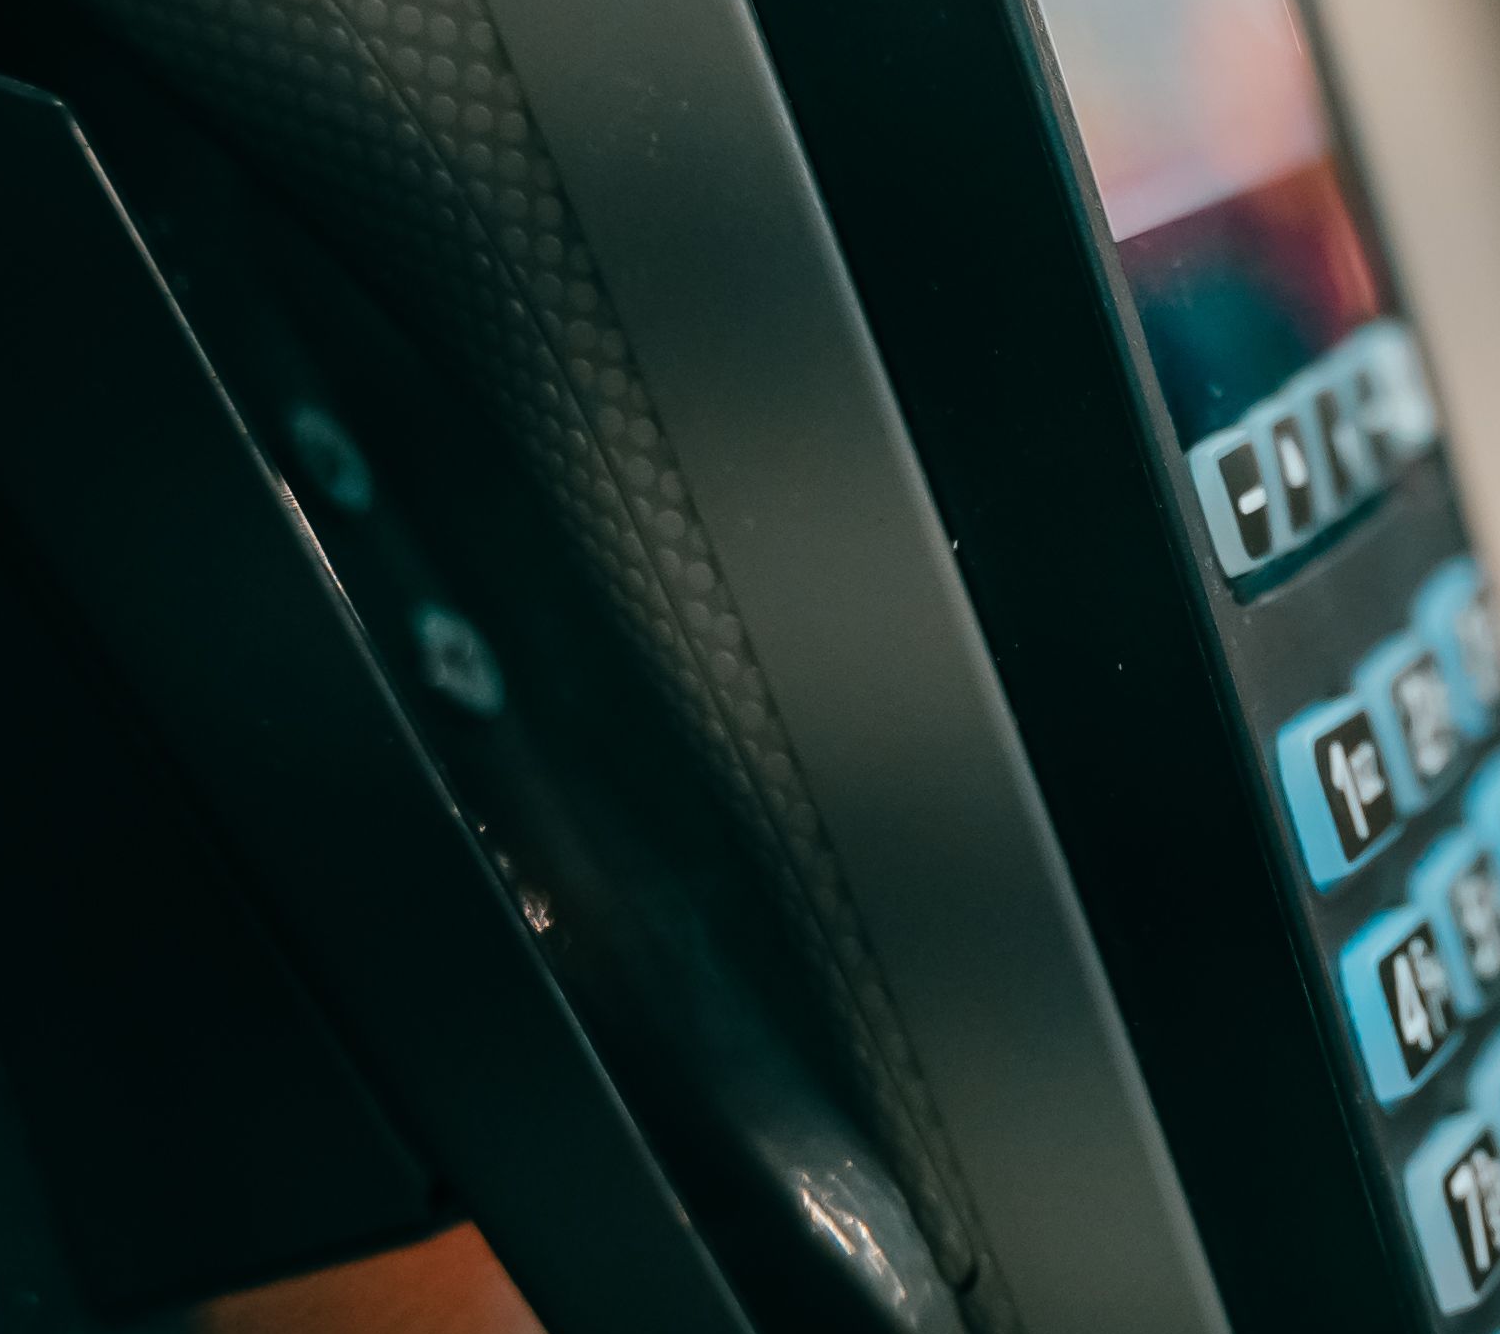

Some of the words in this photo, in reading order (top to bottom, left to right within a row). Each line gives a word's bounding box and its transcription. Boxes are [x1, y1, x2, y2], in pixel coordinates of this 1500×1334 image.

[1328, 740, 1371, 841] 1
[1394, 952, 1433, 1052] 4
[1450, 1164, 1491, 1271] 7
